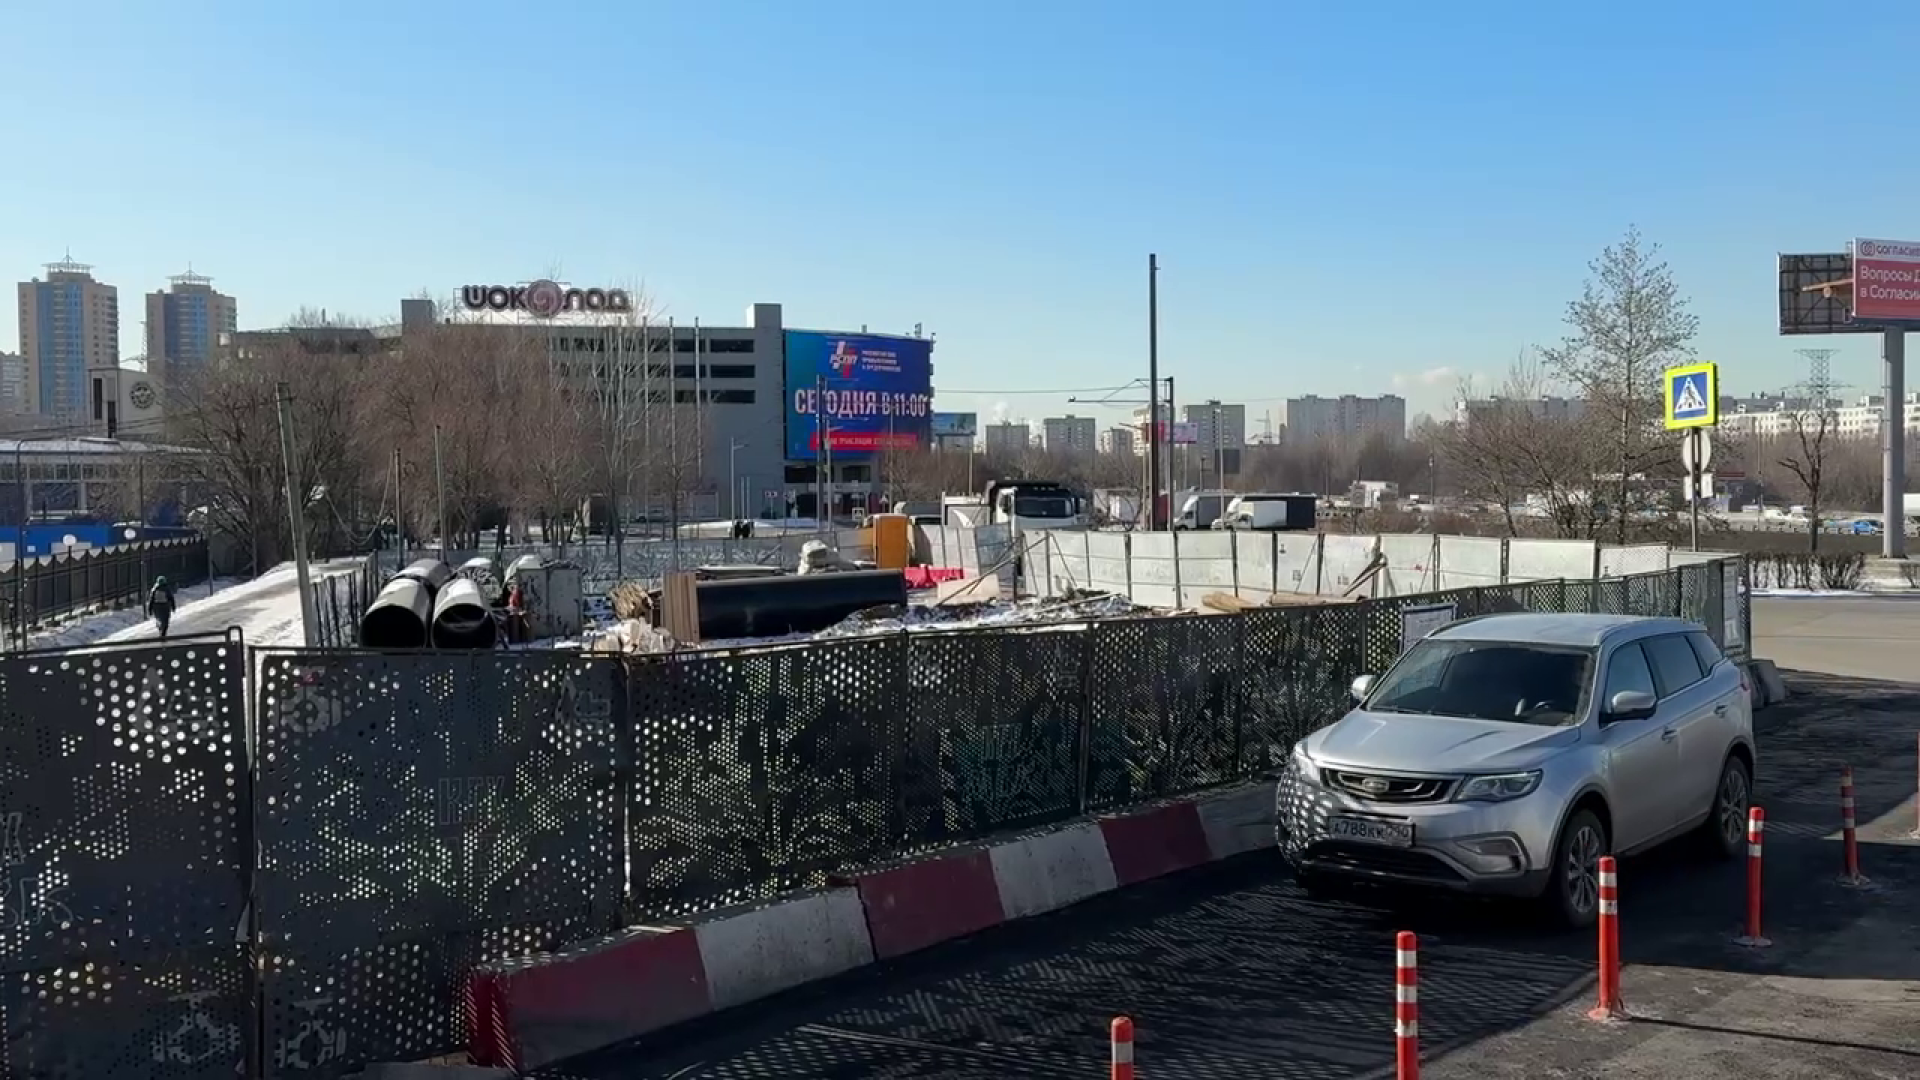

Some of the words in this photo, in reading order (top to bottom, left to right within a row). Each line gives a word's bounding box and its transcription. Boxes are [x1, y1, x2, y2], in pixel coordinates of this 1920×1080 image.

[1861, 266, 1911, 283] Вопросы
[462, 280, 630, 317] ШОКОЛАД
[1861, 287, 1867, 298] в
[795, 389, 877, 418] СЕОДНЯ
[881, 391, 890, 415] В
[894, 392, 926, 418] 11:00
